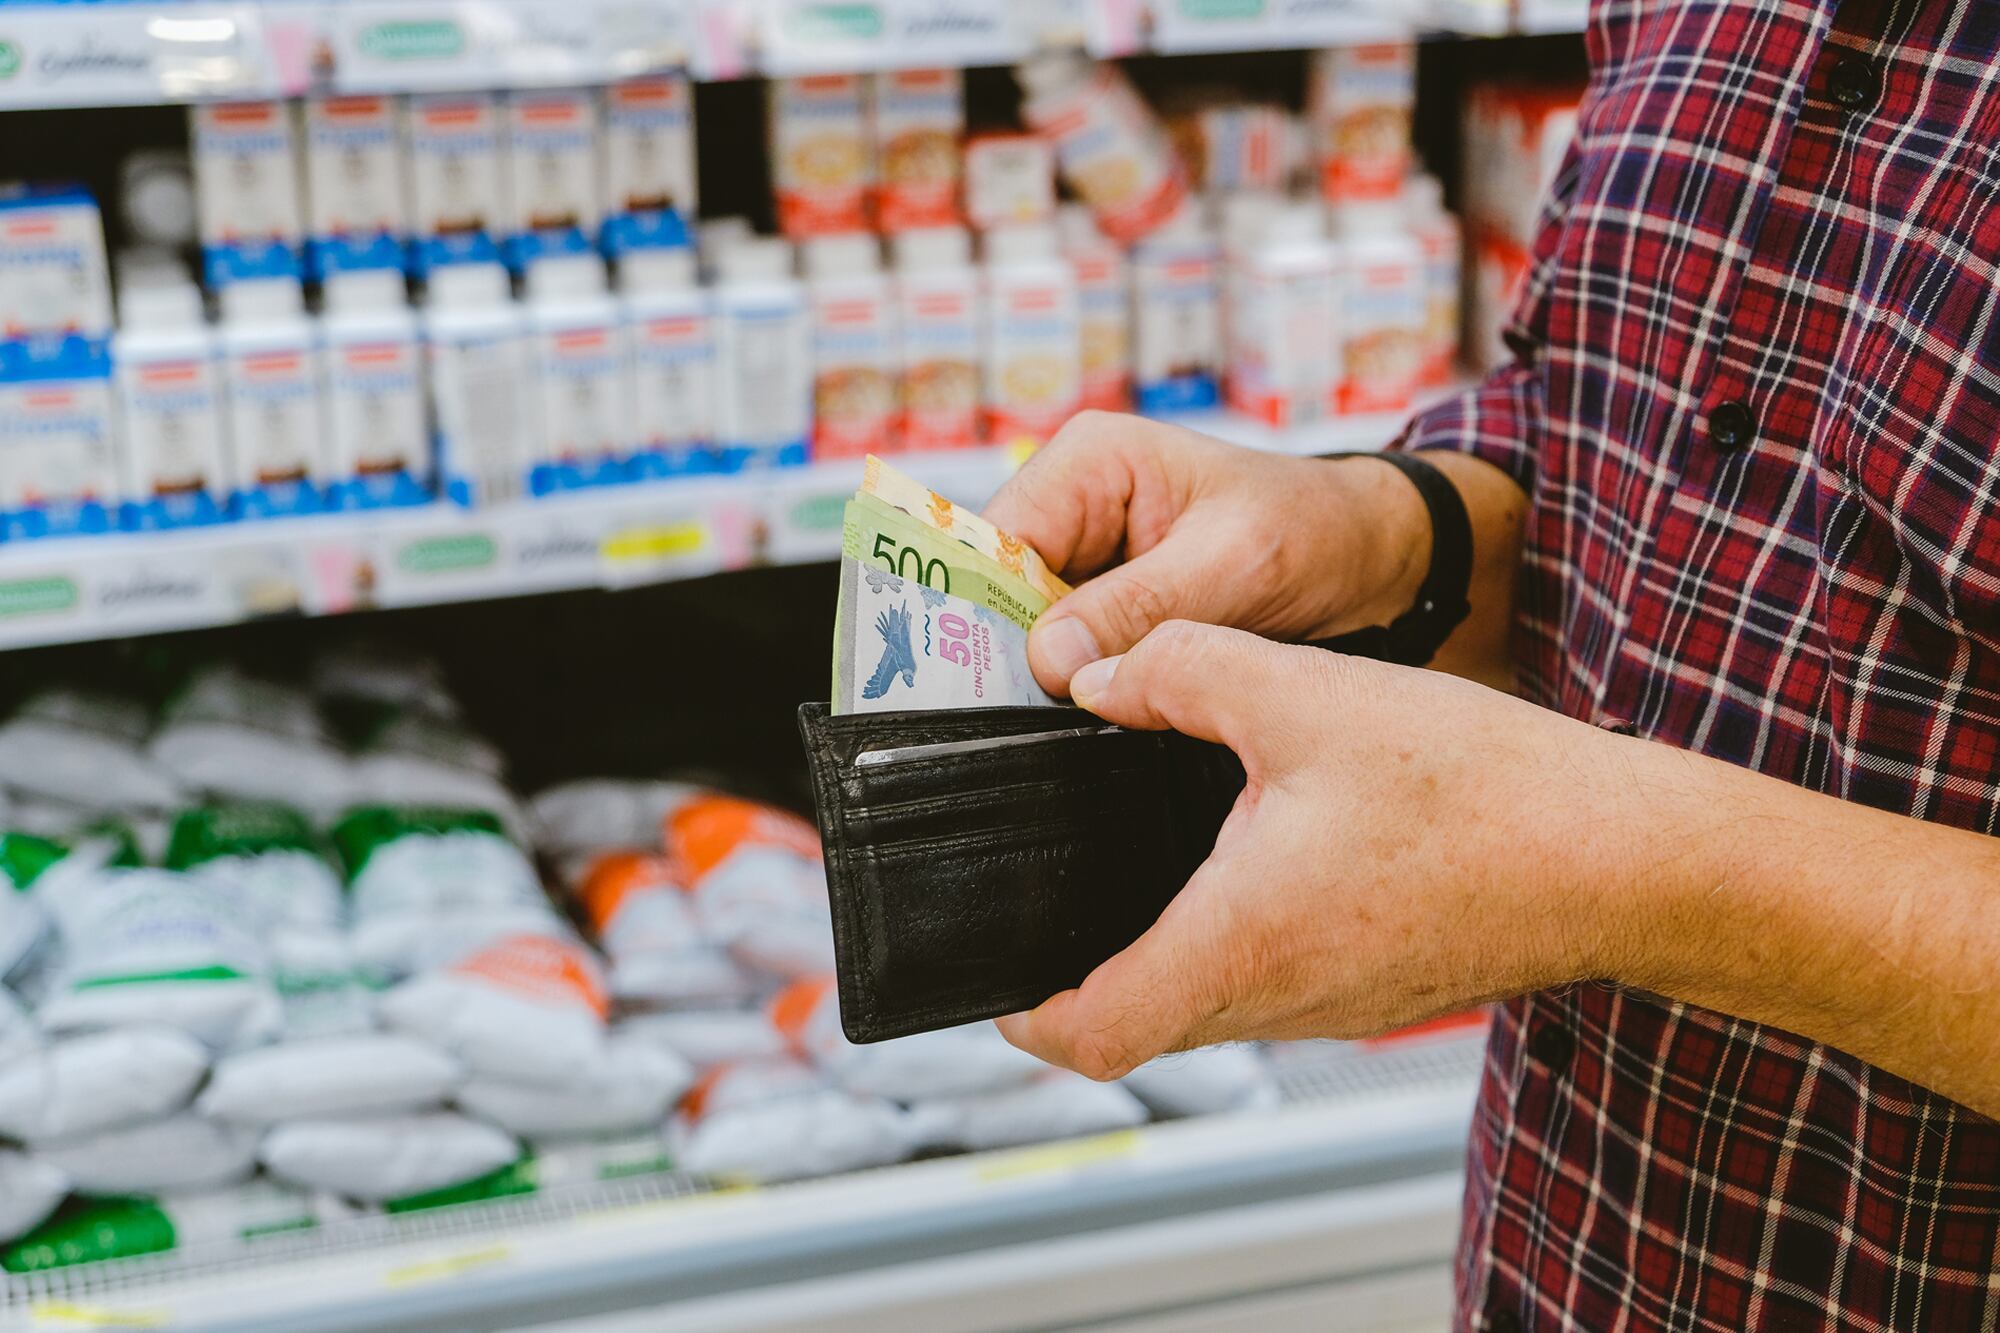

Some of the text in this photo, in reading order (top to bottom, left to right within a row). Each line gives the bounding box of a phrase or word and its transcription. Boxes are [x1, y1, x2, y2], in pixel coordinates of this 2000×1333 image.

[873, 533, 950, 593] 500
[987, 598, 998, 608] en
[938, 613, 971, 667] 50
[972, 624, 984, 698] CINCUENTA
[981, 627, 991, 671] PESOS
